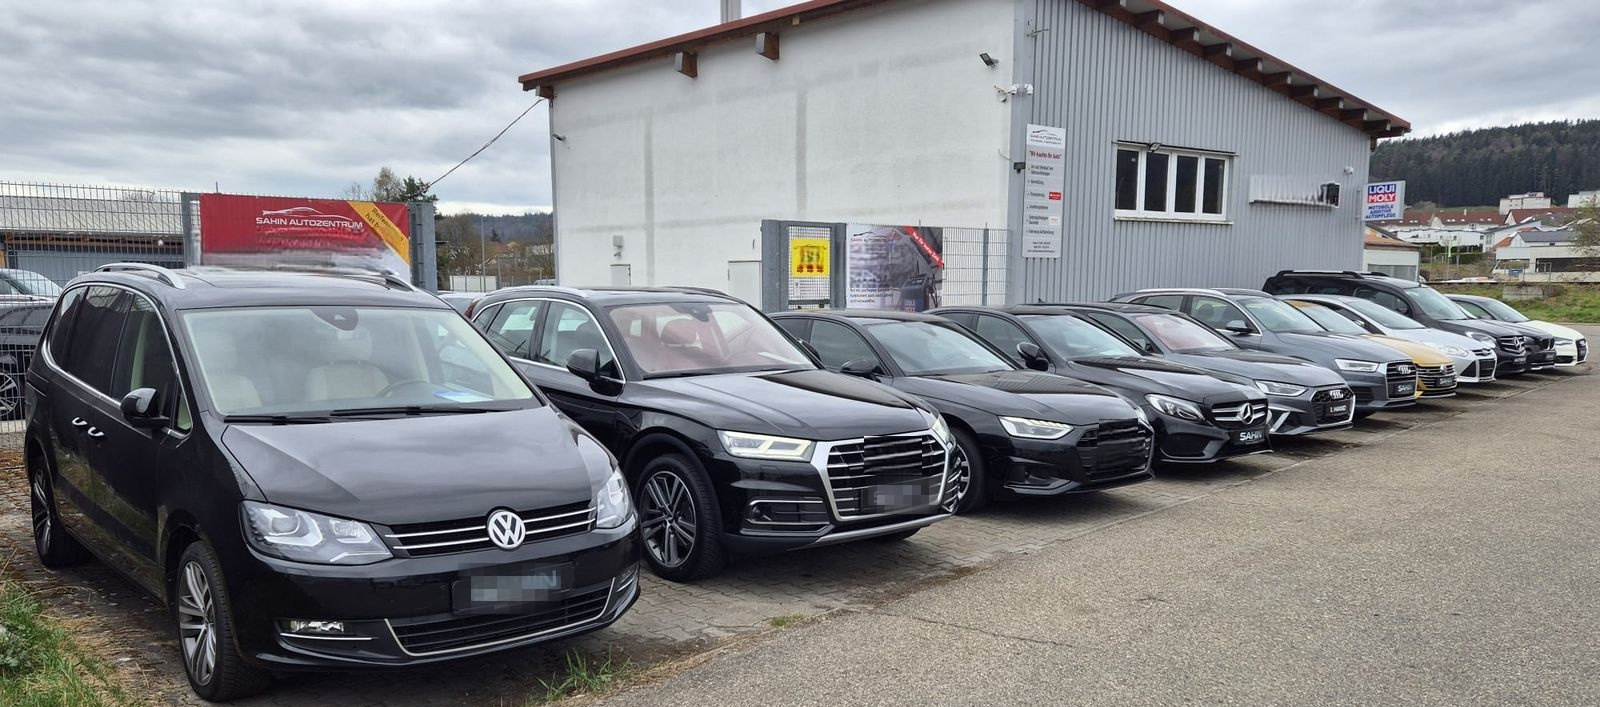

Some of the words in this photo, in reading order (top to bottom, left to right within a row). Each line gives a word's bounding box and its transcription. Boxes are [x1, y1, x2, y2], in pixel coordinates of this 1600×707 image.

[1369, 184, 1396, 194] LIQUI
[1368, 193, 1396, 202] MOLY
[255, 216, 288, 226] SAHIN
[289, 218, 363, 229] AUTOZENTRUM
[1239, 430, 1262, 441] SAHIN
